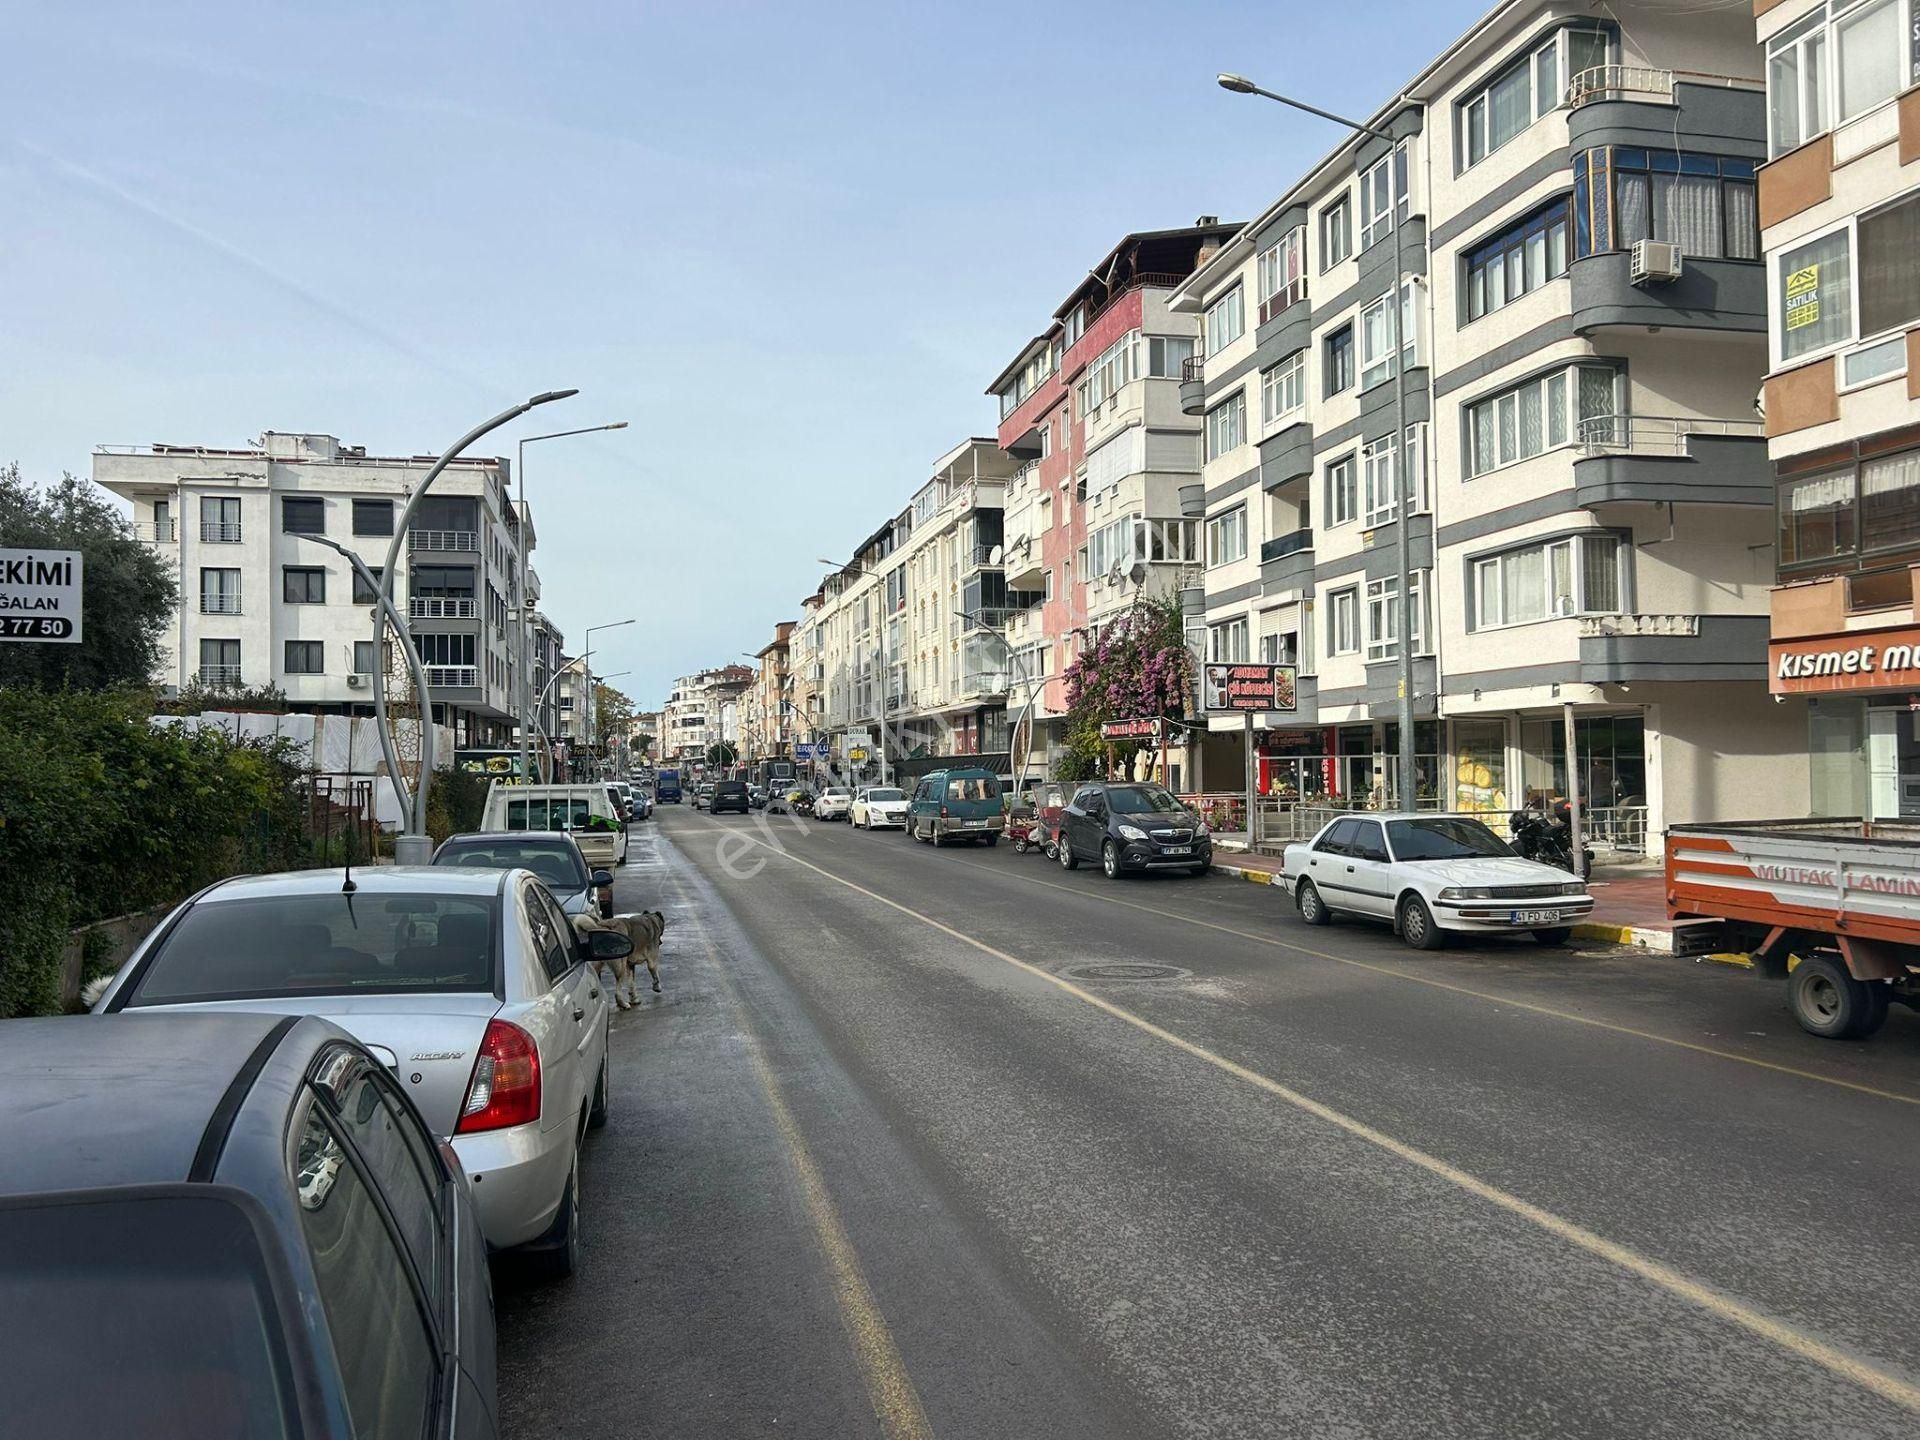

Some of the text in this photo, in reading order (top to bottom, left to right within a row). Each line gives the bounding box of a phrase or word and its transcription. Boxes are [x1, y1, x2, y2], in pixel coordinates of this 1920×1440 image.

[1786, 289, 1818, 311] SATILIK
[10, 619, 35, 634] 77
[40, 620, 64, 635] 50
[797, 744, 829, 753] EROLU
[1757, 864, 1837, 887] MUTFAK
